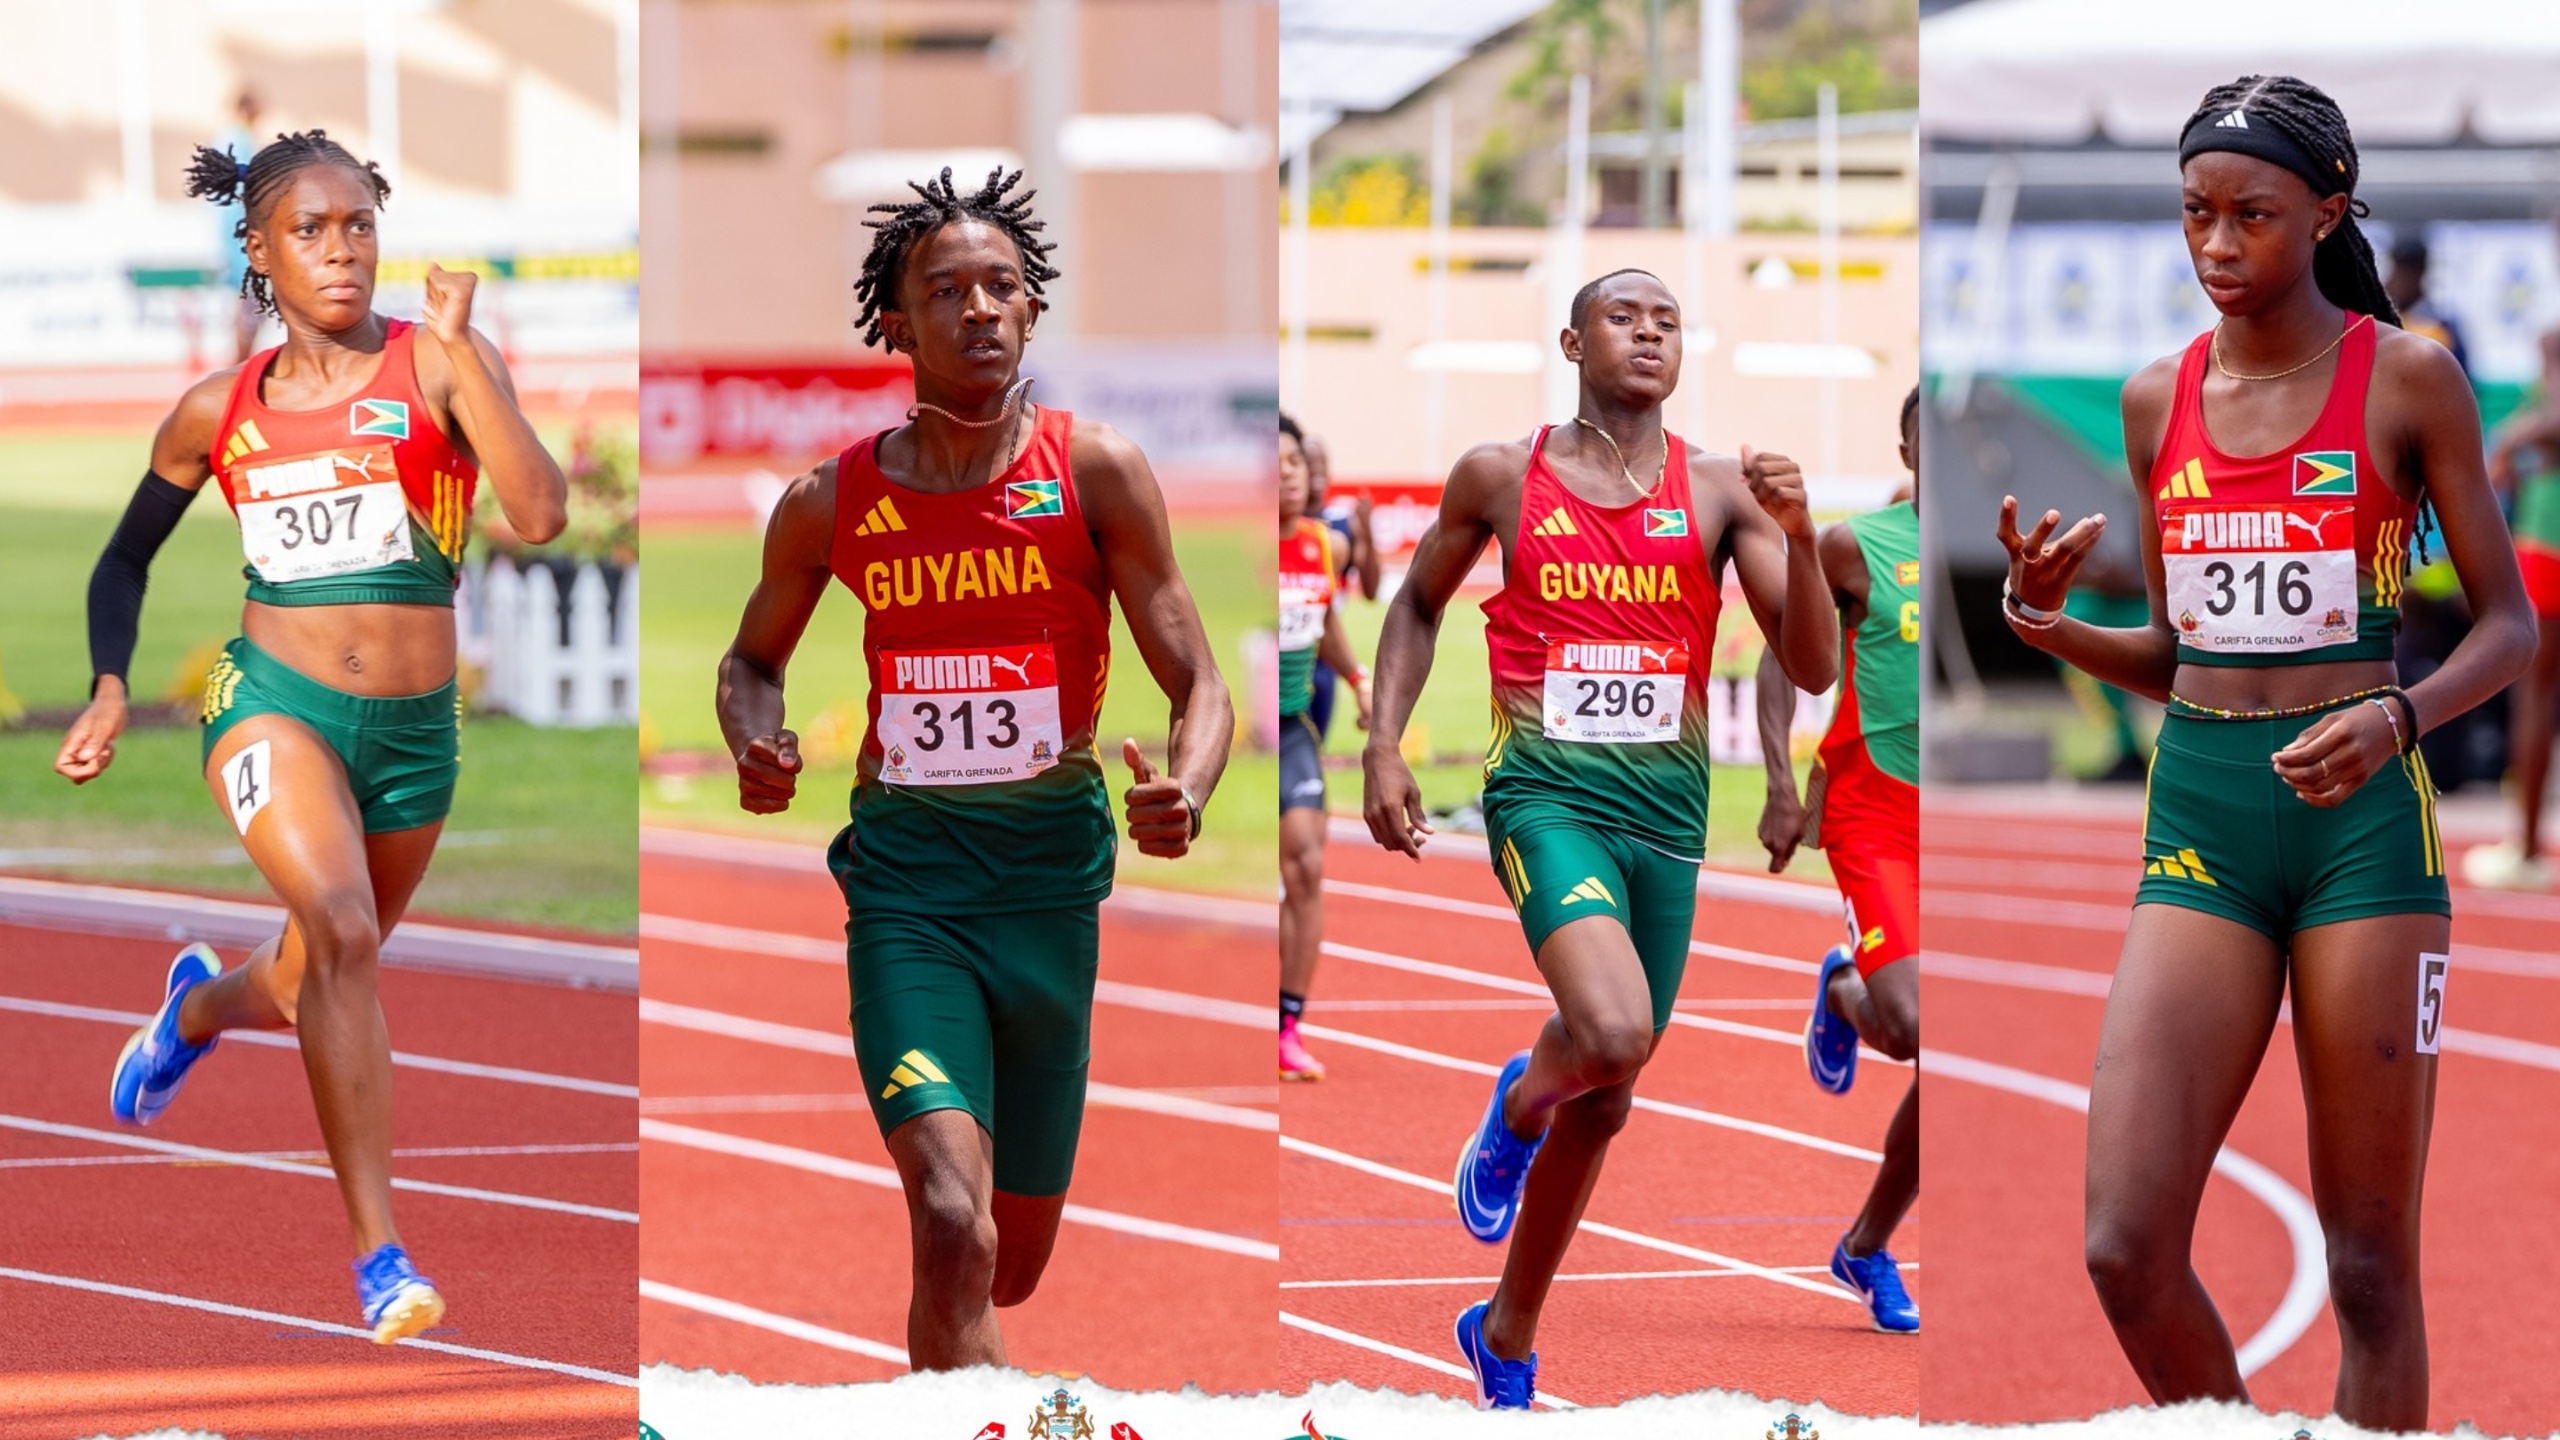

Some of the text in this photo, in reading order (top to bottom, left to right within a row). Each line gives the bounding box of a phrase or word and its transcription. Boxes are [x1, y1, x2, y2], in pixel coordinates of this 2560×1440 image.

[275, 493, 363, 550] 307
[2181, 511, 2285, 550] PUMA
[864, 545, 1052, 611] GUYANA
[1539, 561, 1682, 603] GUYANA
[2203, 560, 2313, 616] 316
[1562, 643, 1641, 672] PUMA
[2214, 636, 2253, 646] CARIFTA
[2254, 635, 2305, 646] GRENADA
[894, 654, 991, 690] PUMA
[1574, 679, 1656, 718] 296
[912, 699, 1020, 752] 313
[1581, 730, 1611, 738] CARIFTA
[1611, 730, 1647, 738] GRENADA
[237, 752, 259, 810] 4
[924, 766, 1014, 779] CARIFTA GRENADA
[2421, 960, 2446, 1047] 5
